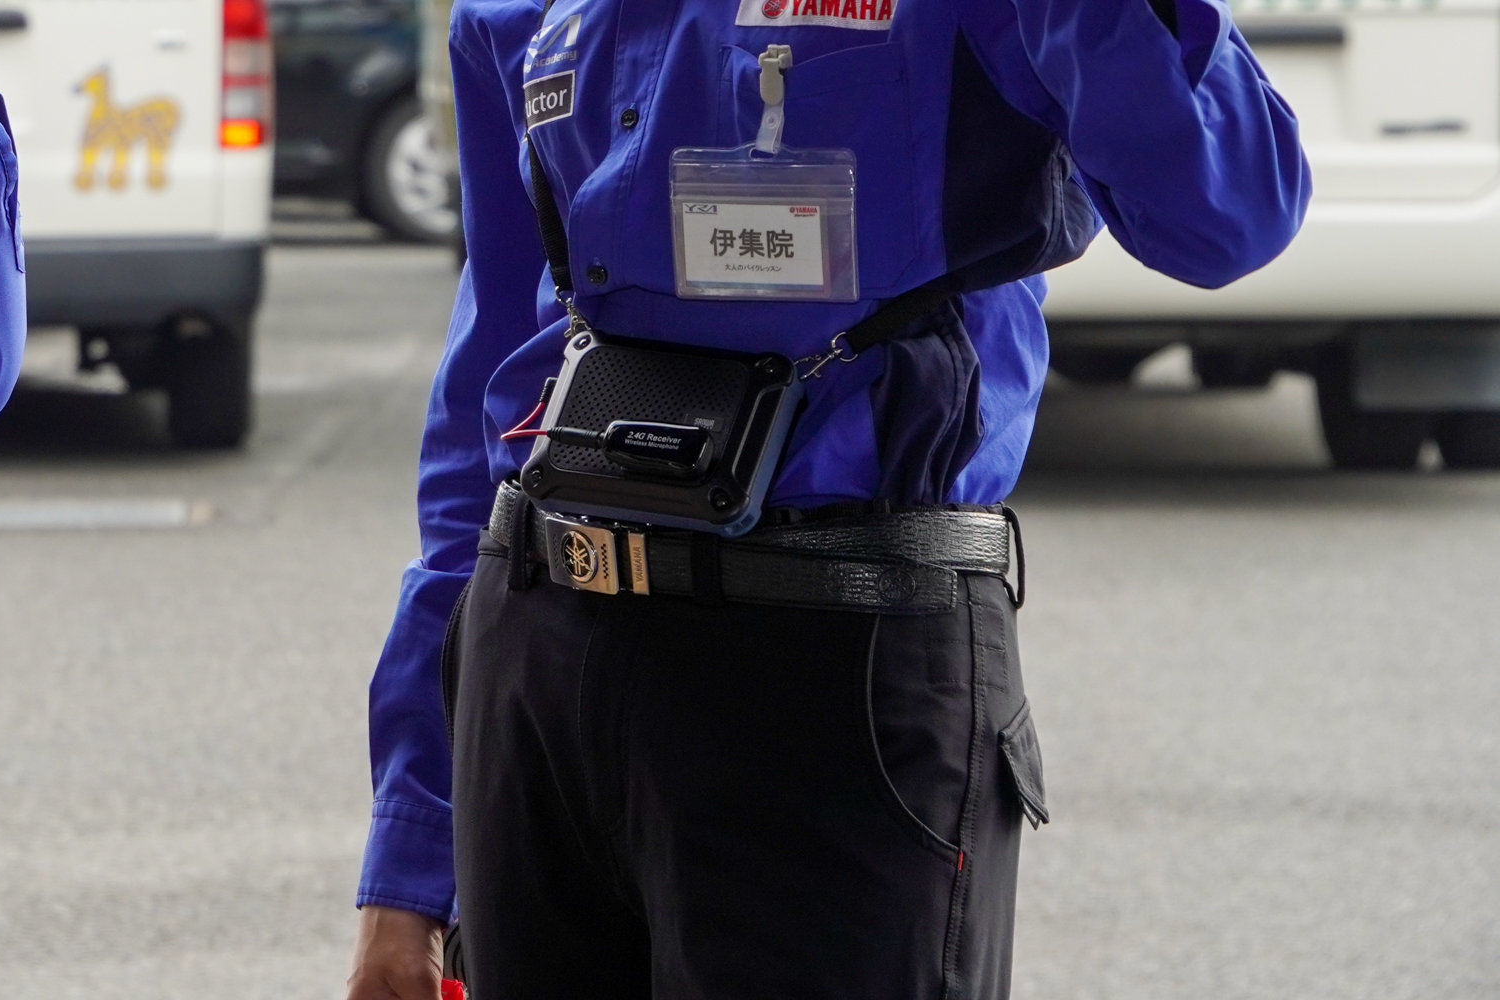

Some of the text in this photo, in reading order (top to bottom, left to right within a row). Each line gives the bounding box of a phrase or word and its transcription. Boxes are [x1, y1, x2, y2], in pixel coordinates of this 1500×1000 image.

[710, 228, 795, 259] 伊集院
[647, 433, 682, 445] Receiver
